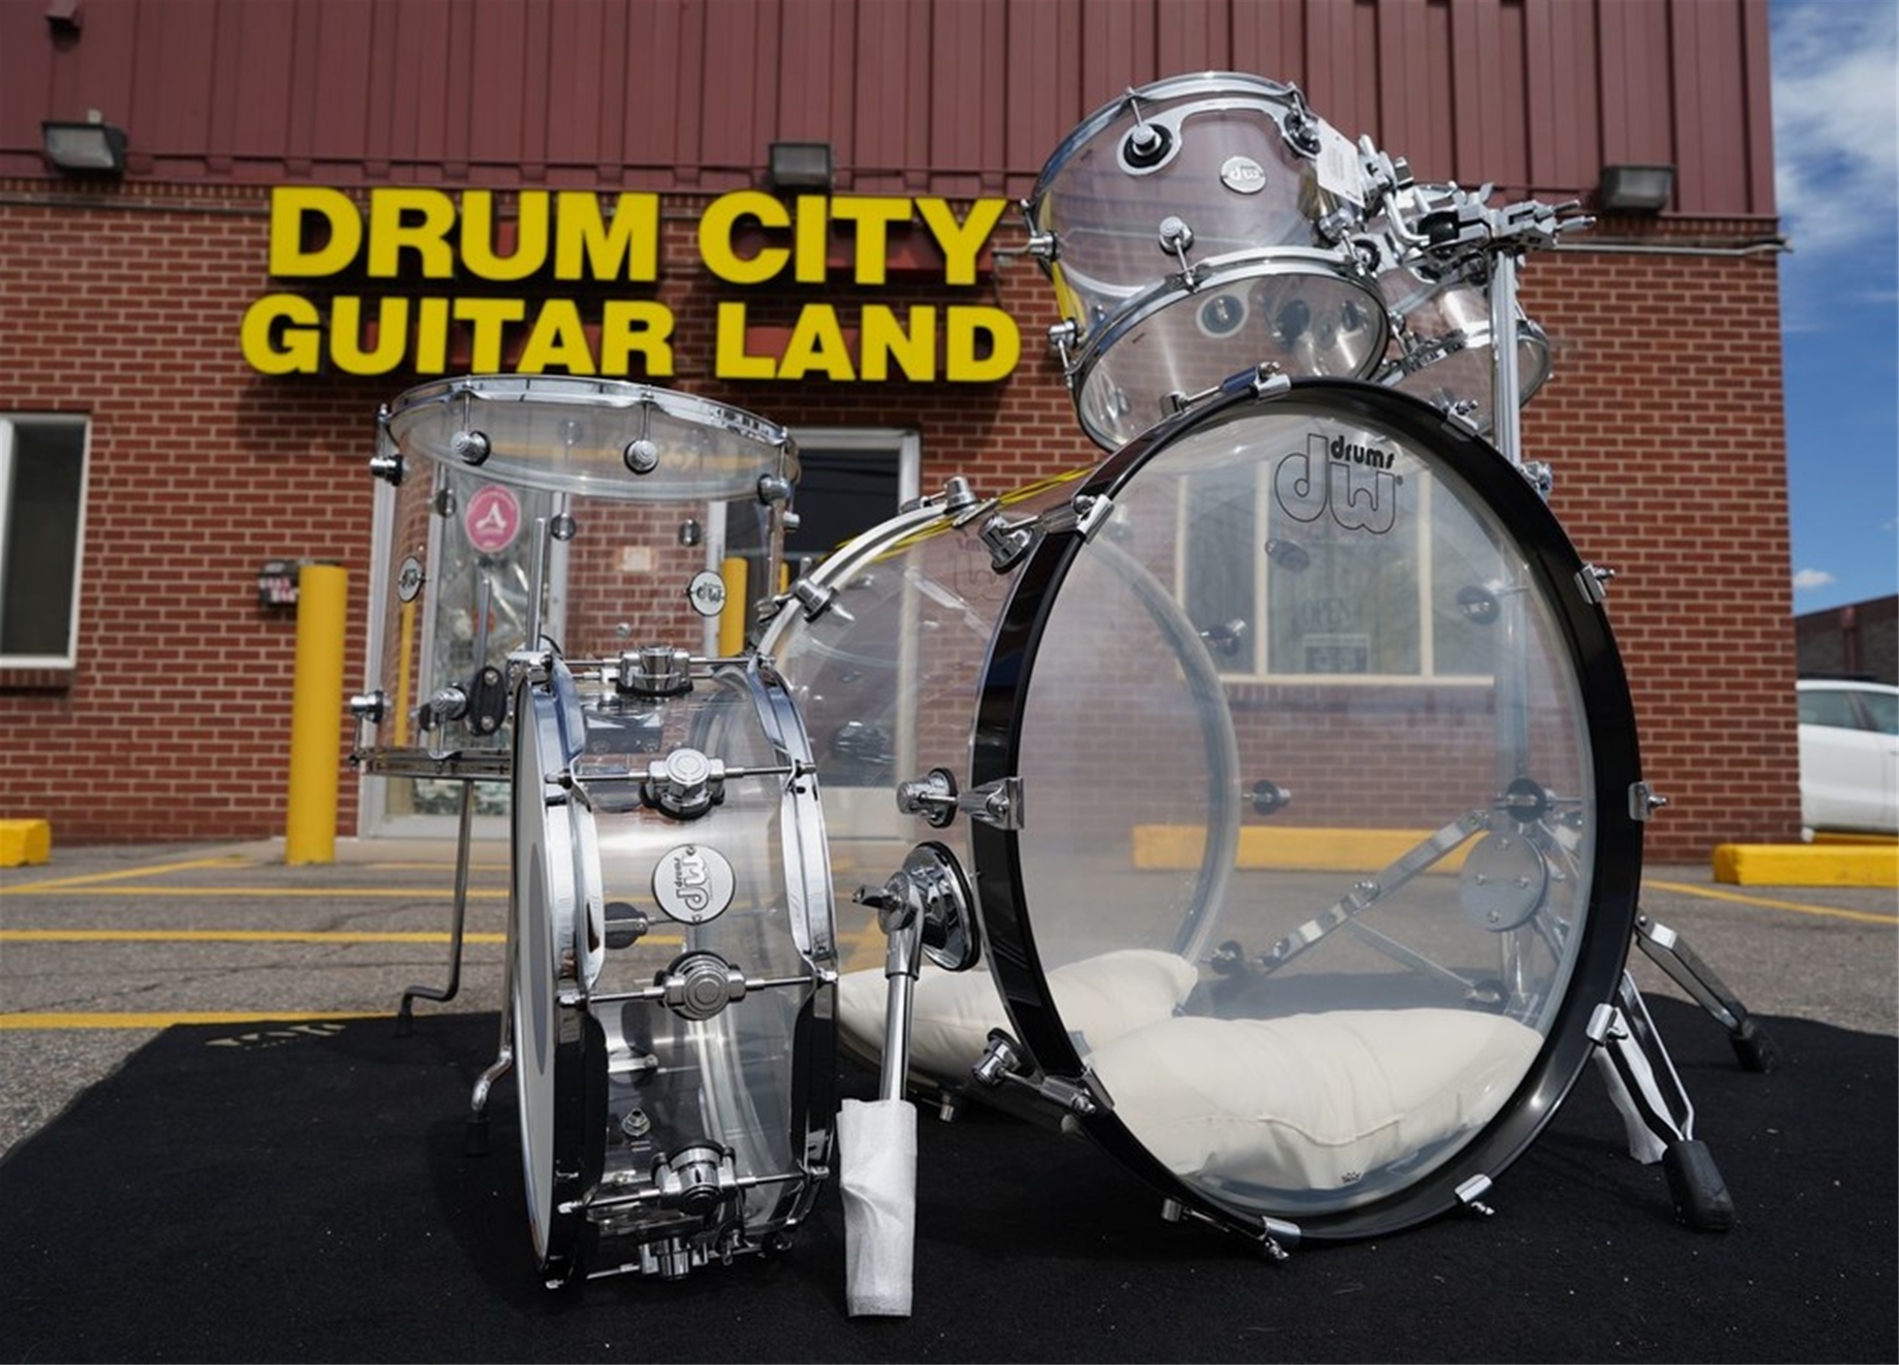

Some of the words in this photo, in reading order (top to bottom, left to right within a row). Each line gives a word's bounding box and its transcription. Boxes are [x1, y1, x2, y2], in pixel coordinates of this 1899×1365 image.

[269, 186, 659, 281] DRUM
[698, 190, 1008, 285] CITY
[239, 294, 676, 377] GUITAR
[716, 302, 1022, 383] LAND
[1274, 432, 1397, 535] dw
[1330, 434, 1395, 470] drums
